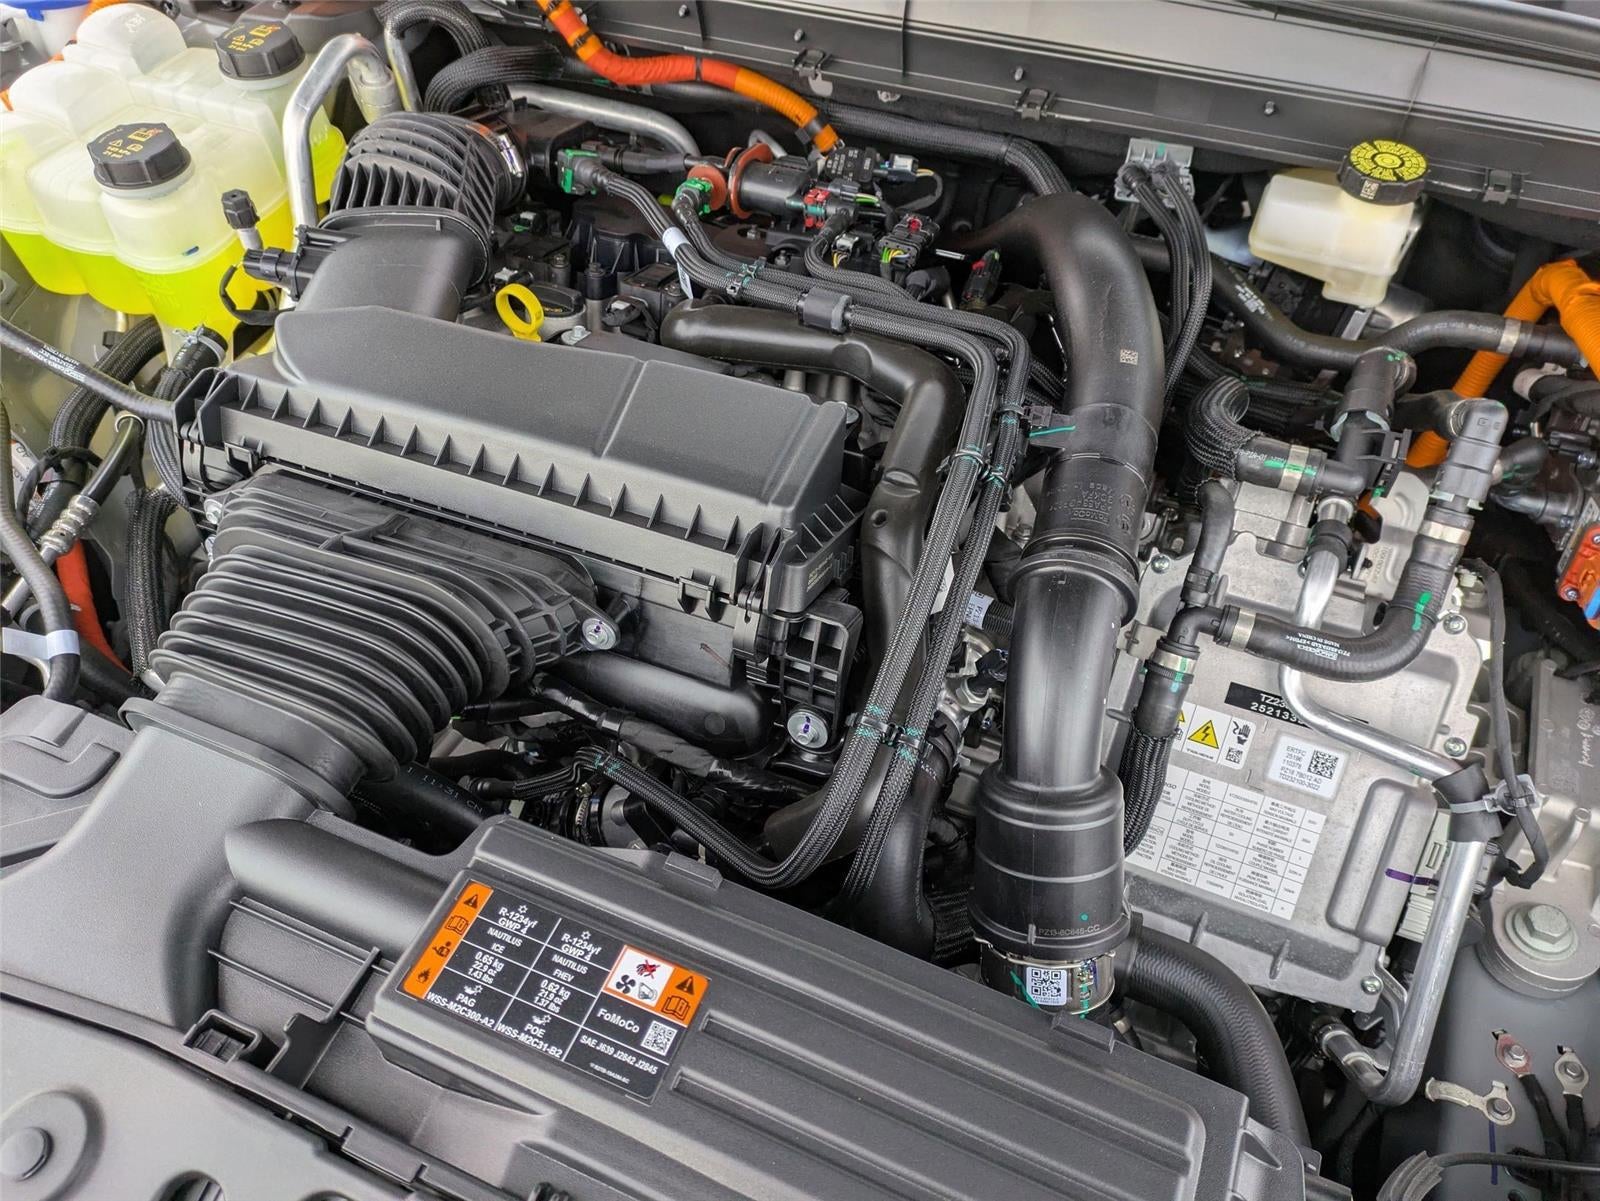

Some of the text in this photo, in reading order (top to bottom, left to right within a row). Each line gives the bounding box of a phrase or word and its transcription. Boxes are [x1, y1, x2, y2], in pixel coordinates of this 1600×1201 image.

[1259, 692, 1289, 708] TZ23
[498, 917, 528, 935] GWP 4
[499, 907, 538, 928] R-1234yf
[487, 927, 523, 947] NAUTILUS
[561, 933, 602, 955] R-1234yf
[491, 942, 505, 954] ICE
[561, 943, 592, 962] GWP 4
[472, 960, 497, 977] 22.9 oz
[474, 951, 505, 972] 0.65 kg
[551, 954, 588, 974] NAUTILUS
[468, 967, 494, 984] 1.43 lbs
[552, 968, 574, 982] FHEV
[537, 988, 564, 1006] 21.9 oz
[540, 979, 571, 1000] 0.62 kg
[455, 993, 476, 1007] PAG
[533, 996, 561, 1013] 1.37 lbs
[426, 992, 495, 1028] WSS-M2C300-A2
[596, 1008, 640, 1033] FoMoCo
[498, 1022, 563, 1058] WSS-M2C31-B2
[524, 1023, 546, 1038] POE
[579, 1034, 598, 1048] SAE
[595, 1042, 615, 1055] J639
[634, 1059, 658, 1075] J2845
